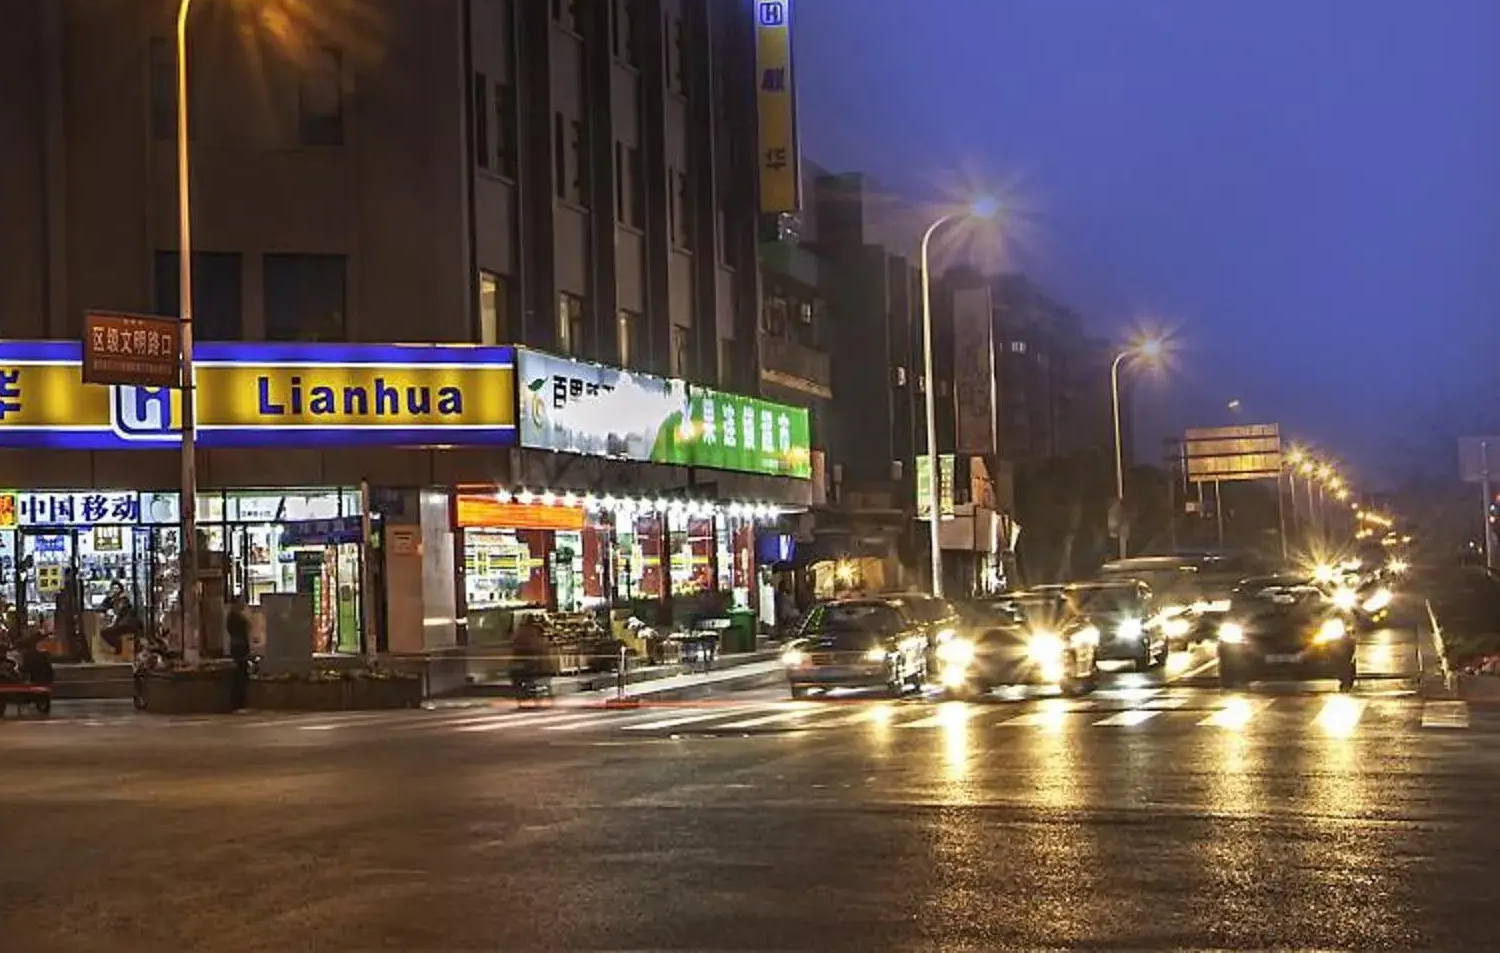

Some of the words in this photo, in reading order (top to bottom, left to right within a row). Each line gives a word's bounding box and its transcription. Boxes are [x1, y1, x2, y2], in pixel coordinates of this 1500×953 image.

[257, 376, 463, 416] Lianhua
[20, 495, 140, 523] 中国移动
